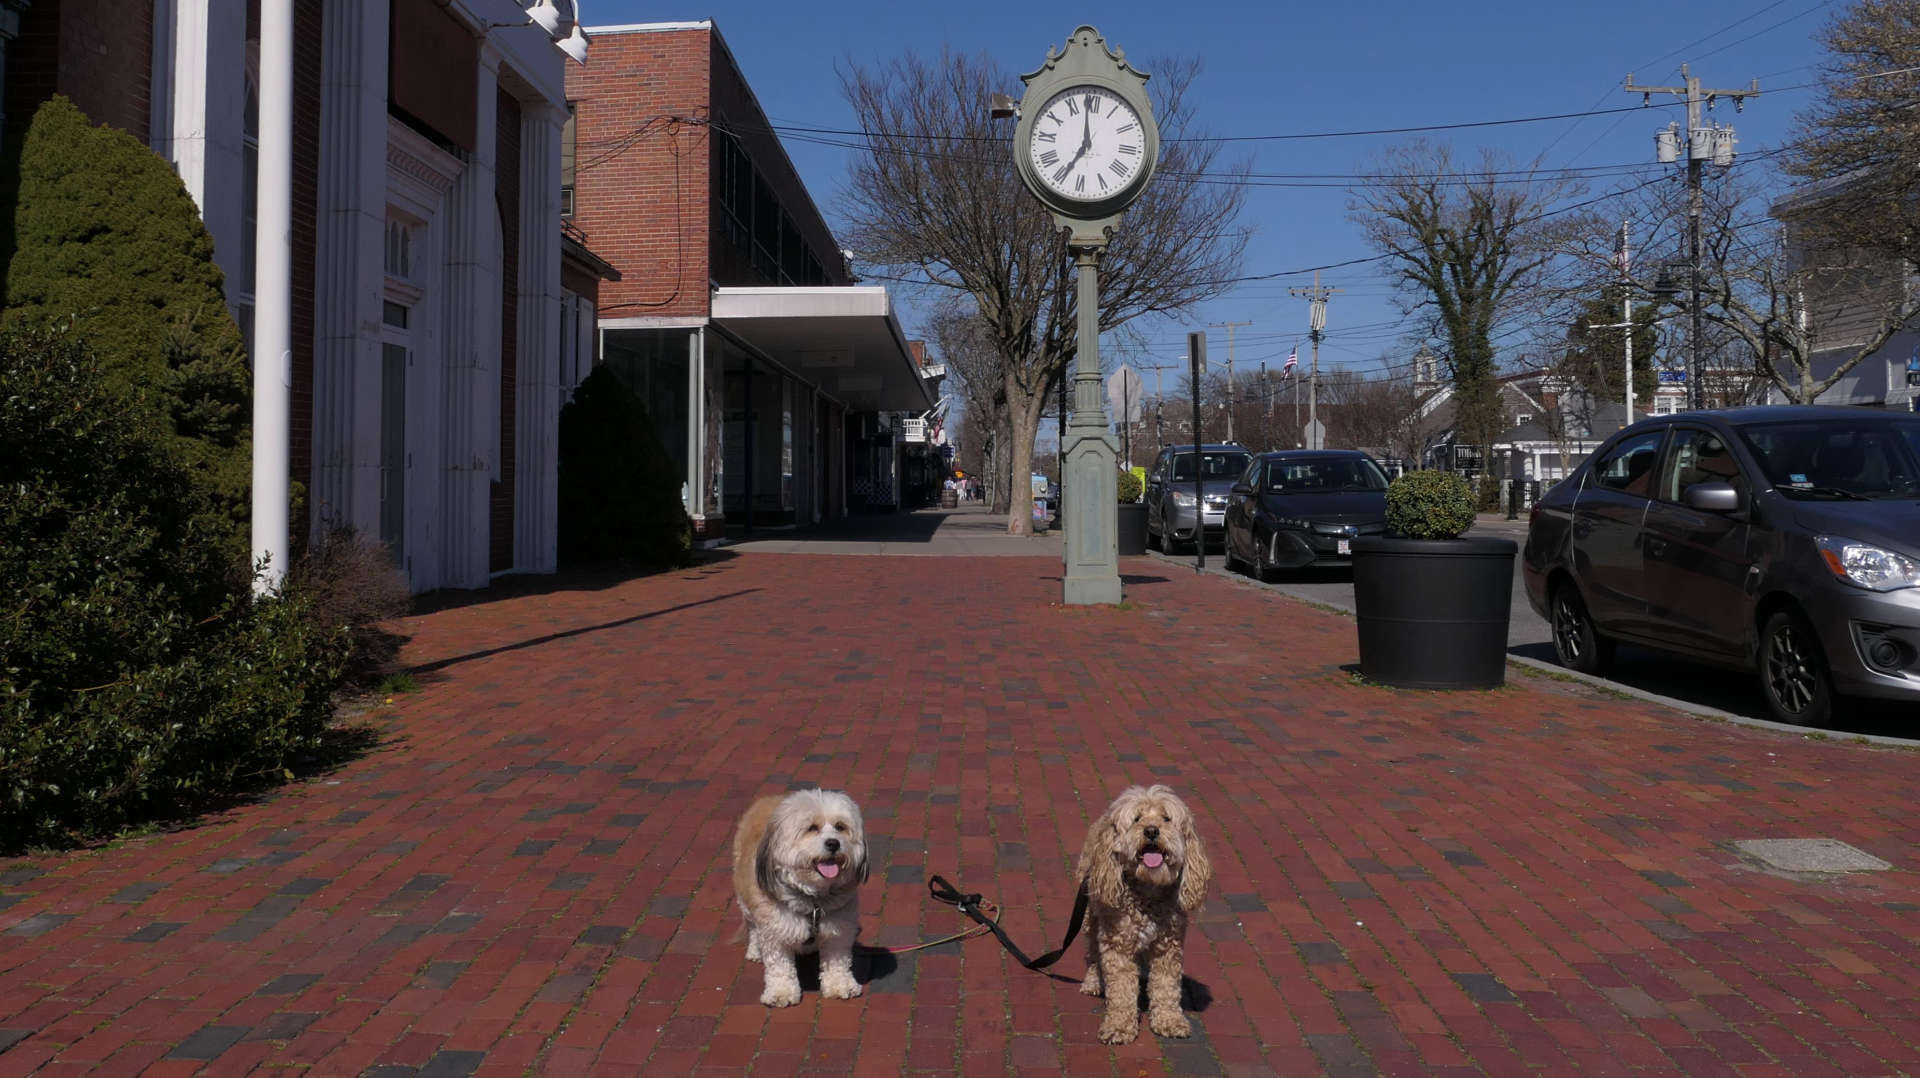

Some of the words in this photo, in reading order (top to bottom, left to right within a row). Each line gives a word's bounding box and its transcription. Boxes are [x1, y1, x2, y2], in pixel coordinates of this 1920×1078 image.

[1065, 97, 1079, 116] XI
[1047, 111, 1064, 126] X
[1116, 124, 1134, 134] II
[1038, 132, 1056, 143] IX
[1119, 145, 1137, 155] III
[1040, 150, 1059, 168] VIII
[1075, 174, 1085, 192] VI
[1097, 174, 1108, 190] V
